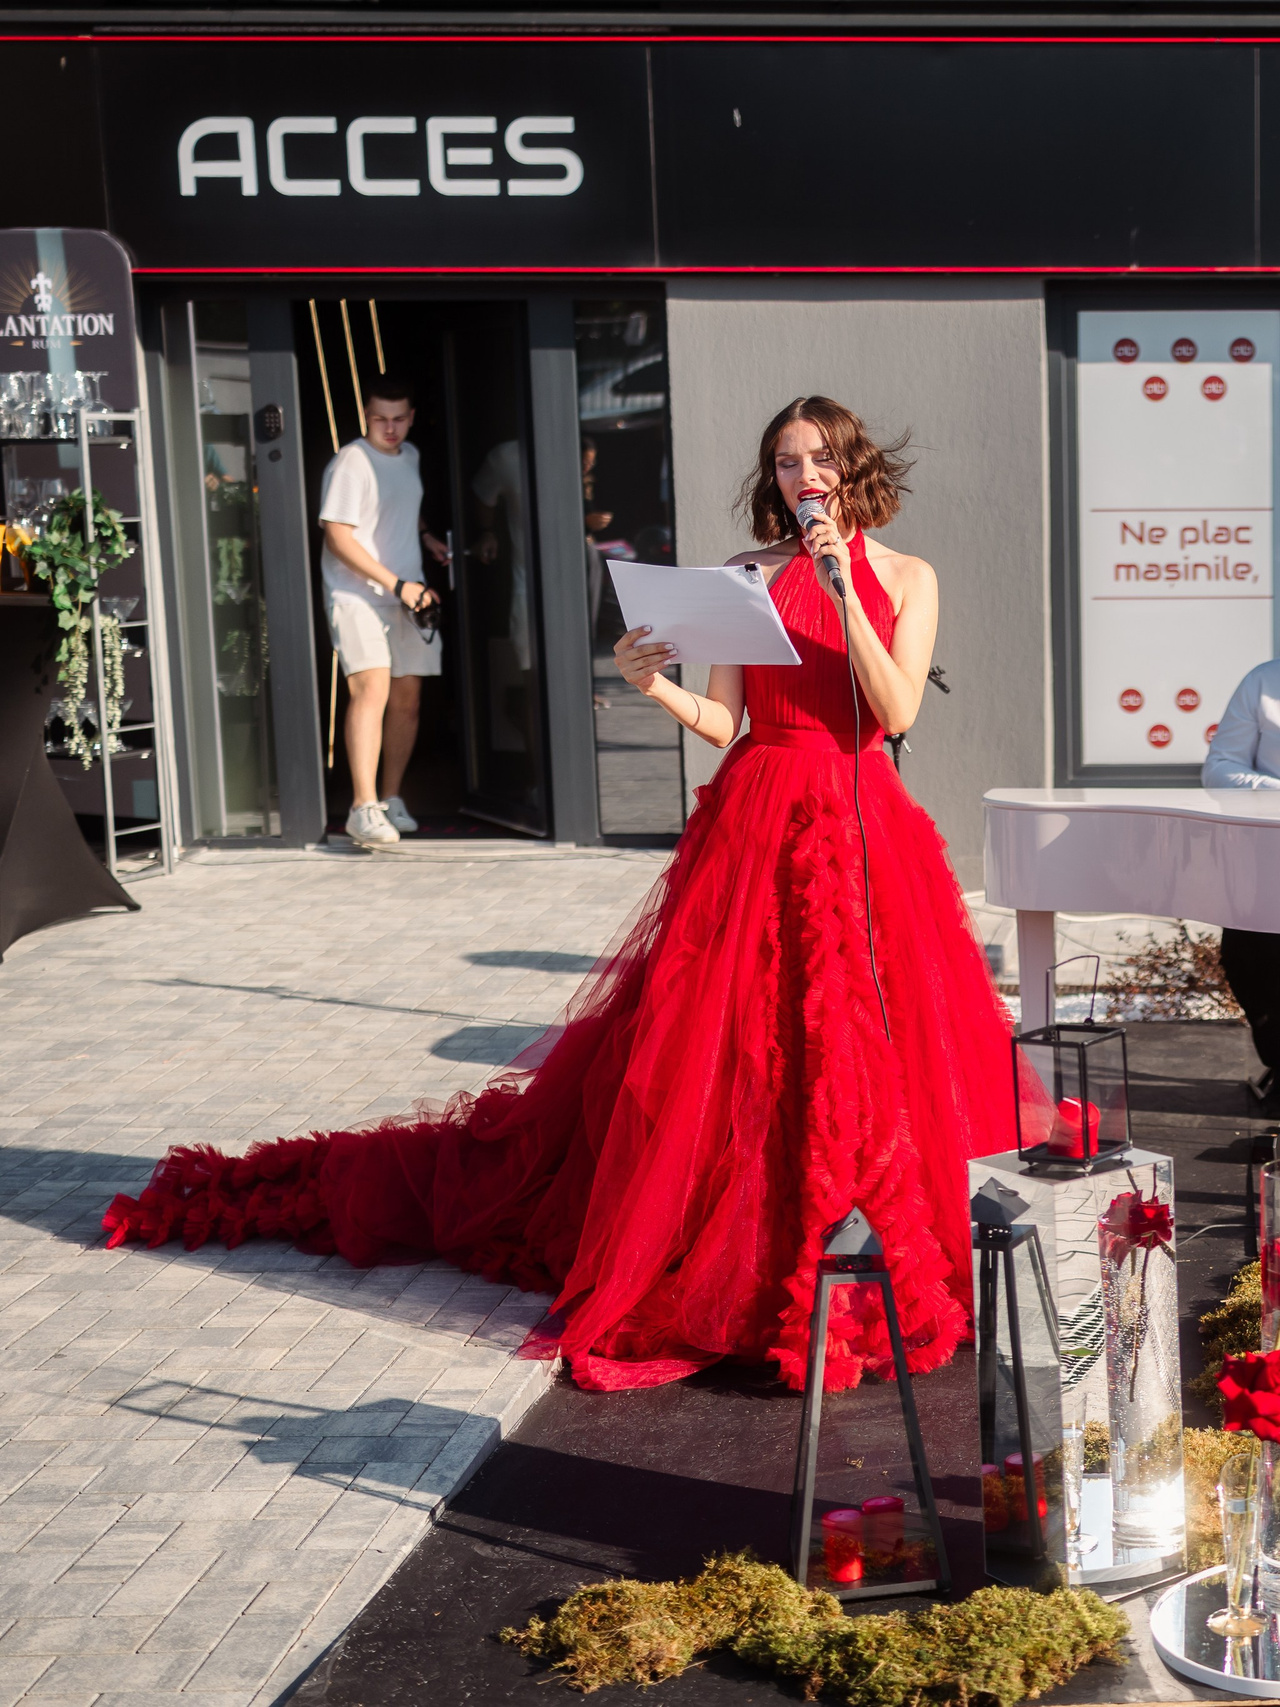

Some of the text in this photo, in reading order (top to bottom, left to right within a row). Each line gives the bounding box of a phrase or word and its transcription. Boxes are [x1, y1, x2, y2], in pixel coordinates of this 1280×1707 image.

[178, 116, 584, 197] ACCES
[31, 338, 61, 350] RUM
[1120, 519, 1253, 551] Ne plac
